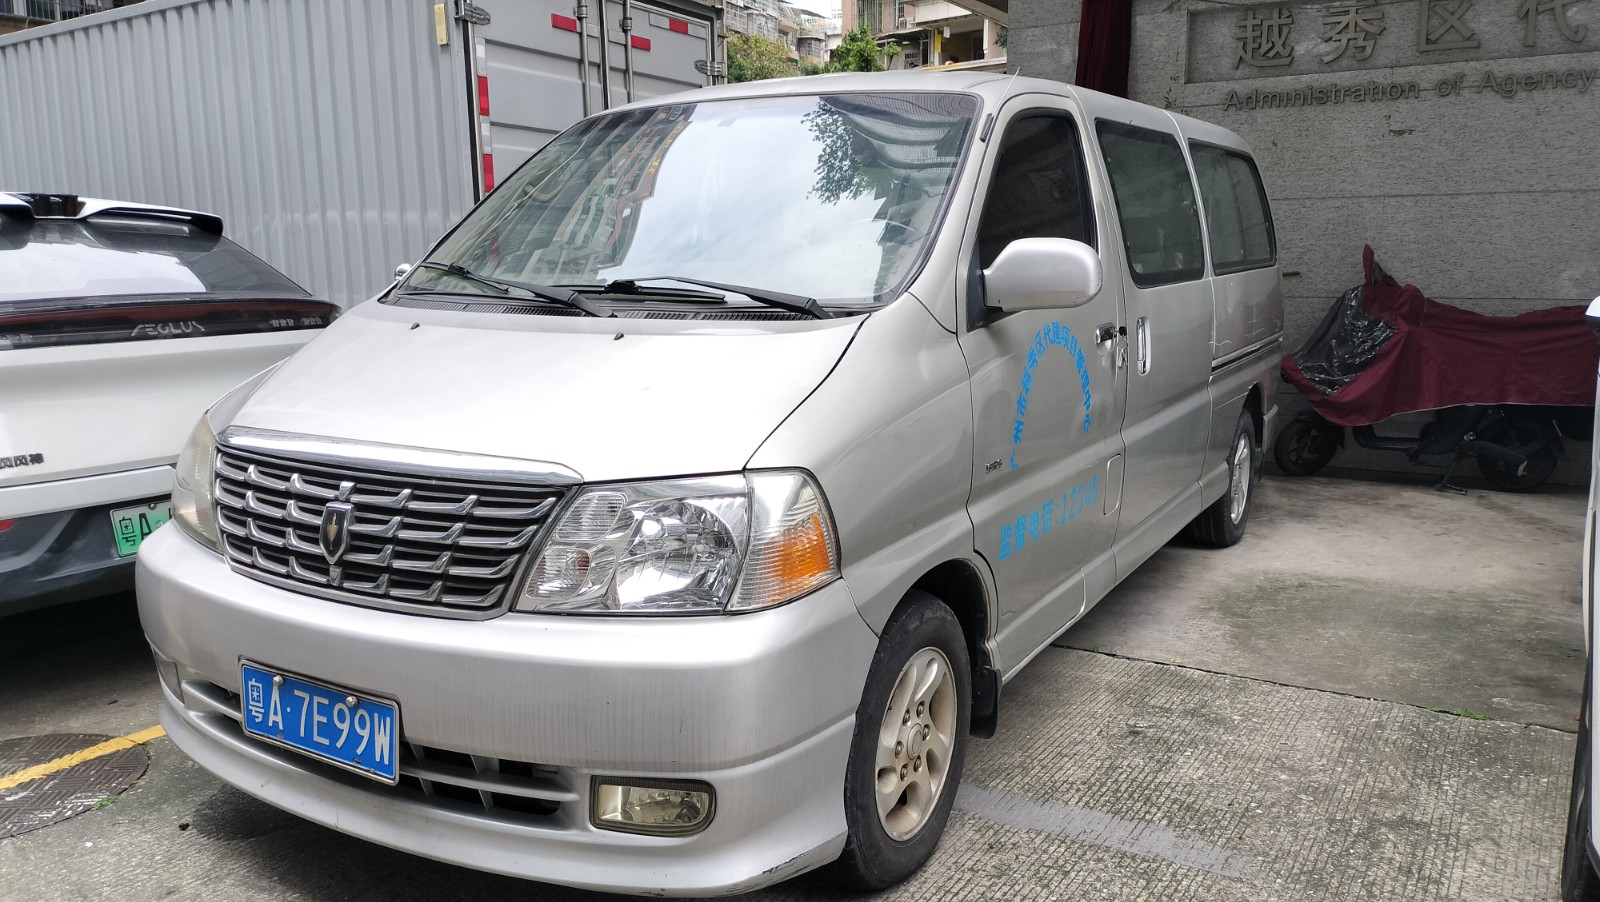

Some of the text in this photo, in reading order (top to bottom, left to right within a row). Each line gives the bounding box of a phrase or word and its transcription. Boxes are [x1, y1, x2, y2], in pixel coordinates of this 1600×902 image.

[1234, 0, 1588, 71] 越秀区代
[1223, 67, 1597, 111] Administration of Agency
